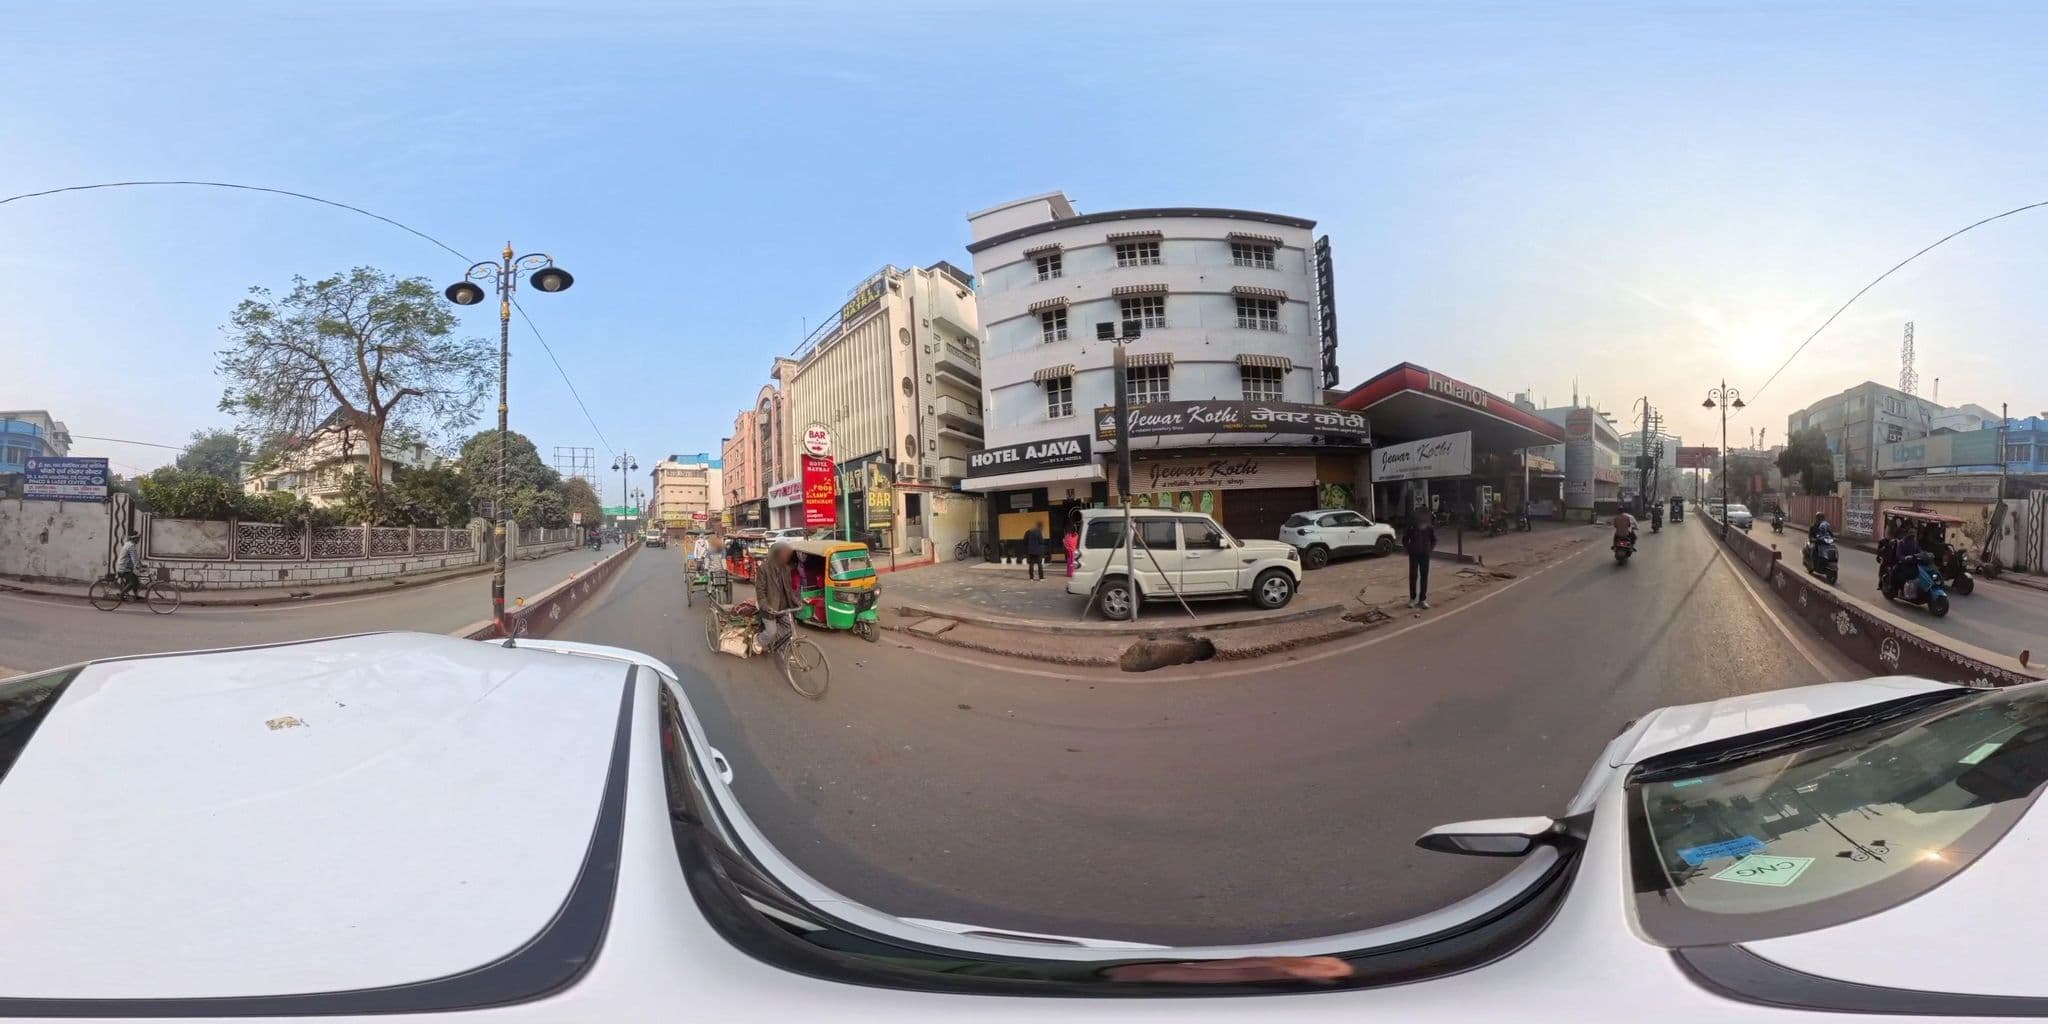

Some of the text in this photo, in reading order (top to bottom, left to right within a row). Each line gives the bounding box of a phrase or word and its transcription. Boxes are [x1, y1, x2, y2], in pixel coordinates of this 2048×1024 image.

[1322, 305, 1334, 385] AJAYA
[1428, 372, 1488, 408] IndianOil
[1128, 409, 1182, 432] Jewar
[1187, 406, 1239, 423] Kothi
[1250, 407, 1310, 424] जेवर
[1314, 411, 1367, 428] कोठी
[809, 430, 826, 439] BAR
[972, 440, 1082, 467] HOTEL AJAYA
[1150, 459, 1258, 488] Jewar Kothi
[868, 492, 891, 507] BAR
[1736, 861, 1795, 877] CNG
